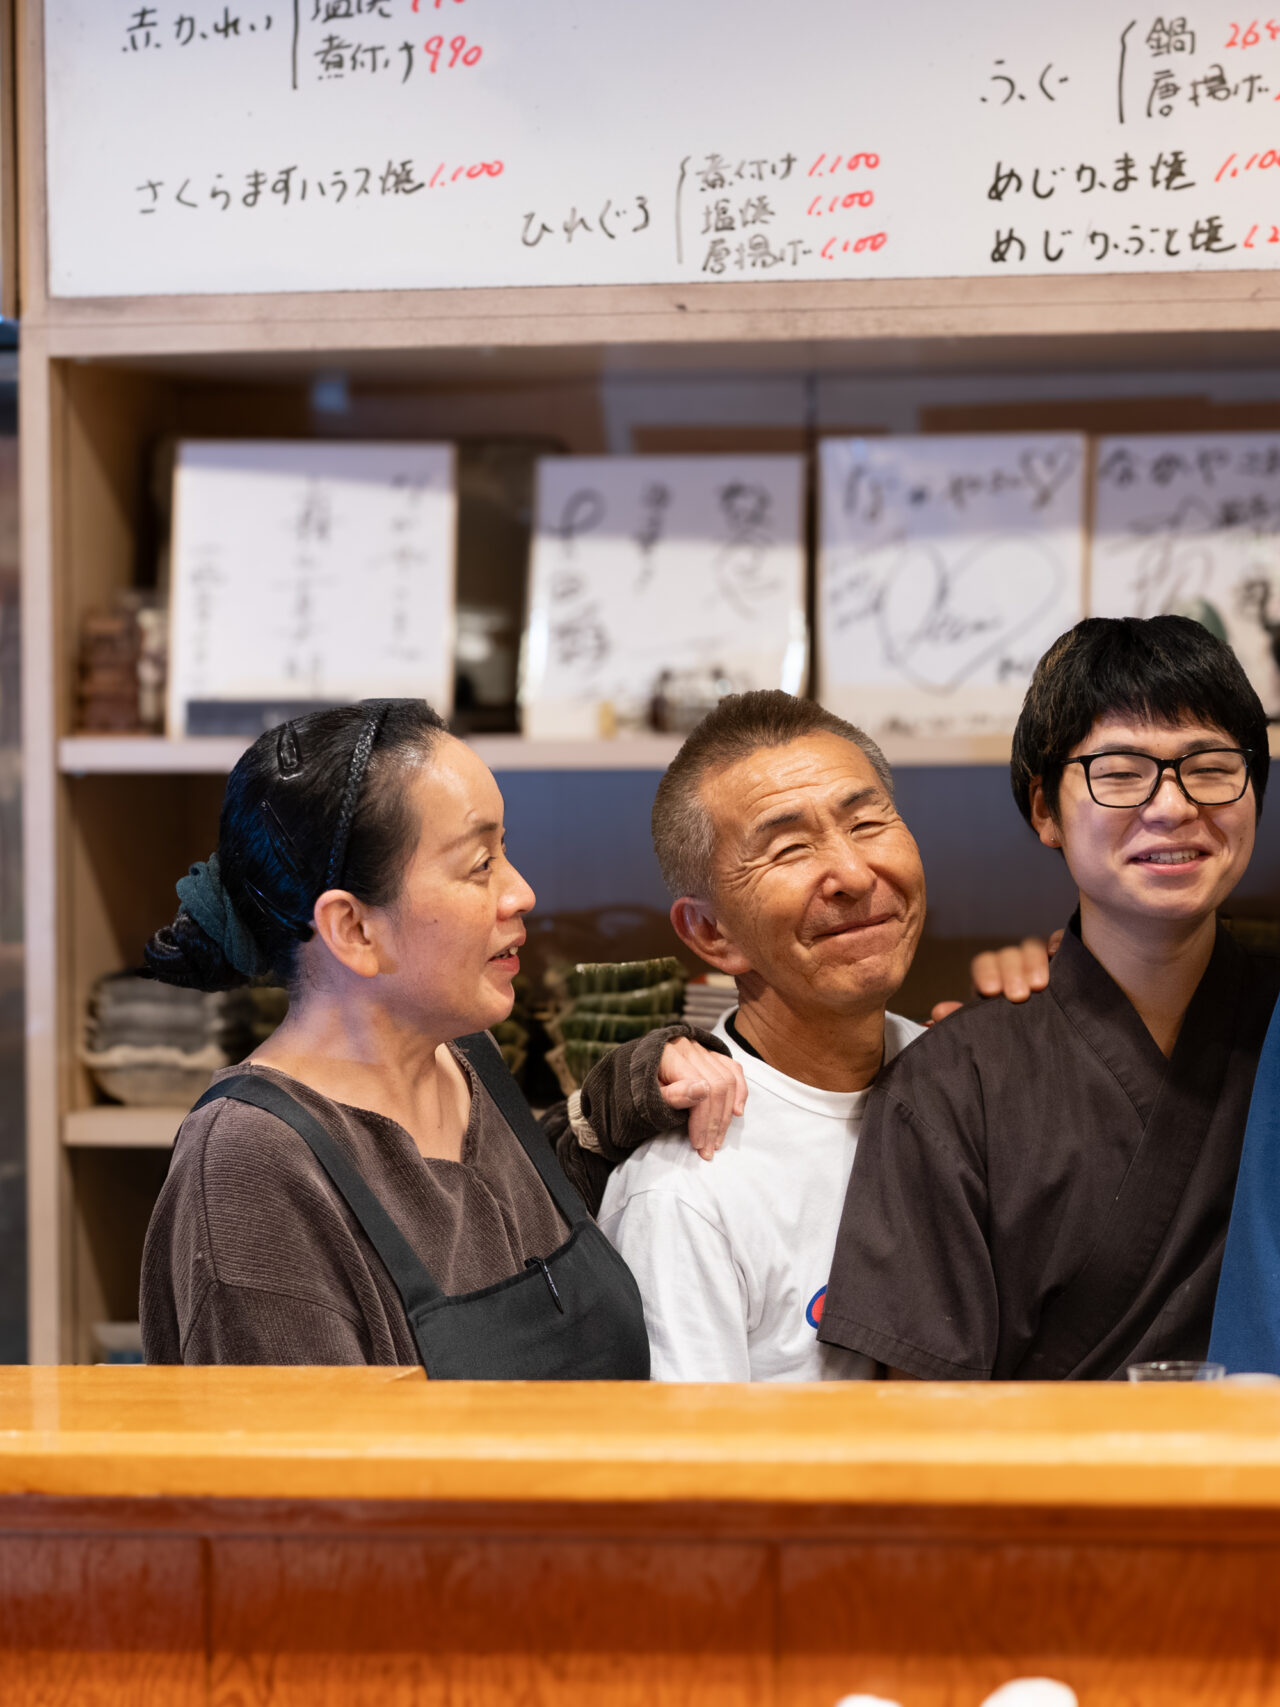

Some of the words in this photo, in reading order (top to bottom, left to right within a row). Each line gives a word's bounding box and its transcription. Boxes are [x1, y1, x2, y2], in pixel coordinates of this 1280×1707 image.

[313, 33, 415, 84] 煮付け
[423, 34, 483, 74] 990
[1145, 16, 1196, 58] 鍋
[1145, 63, 1270, 119] 唐揚げ
